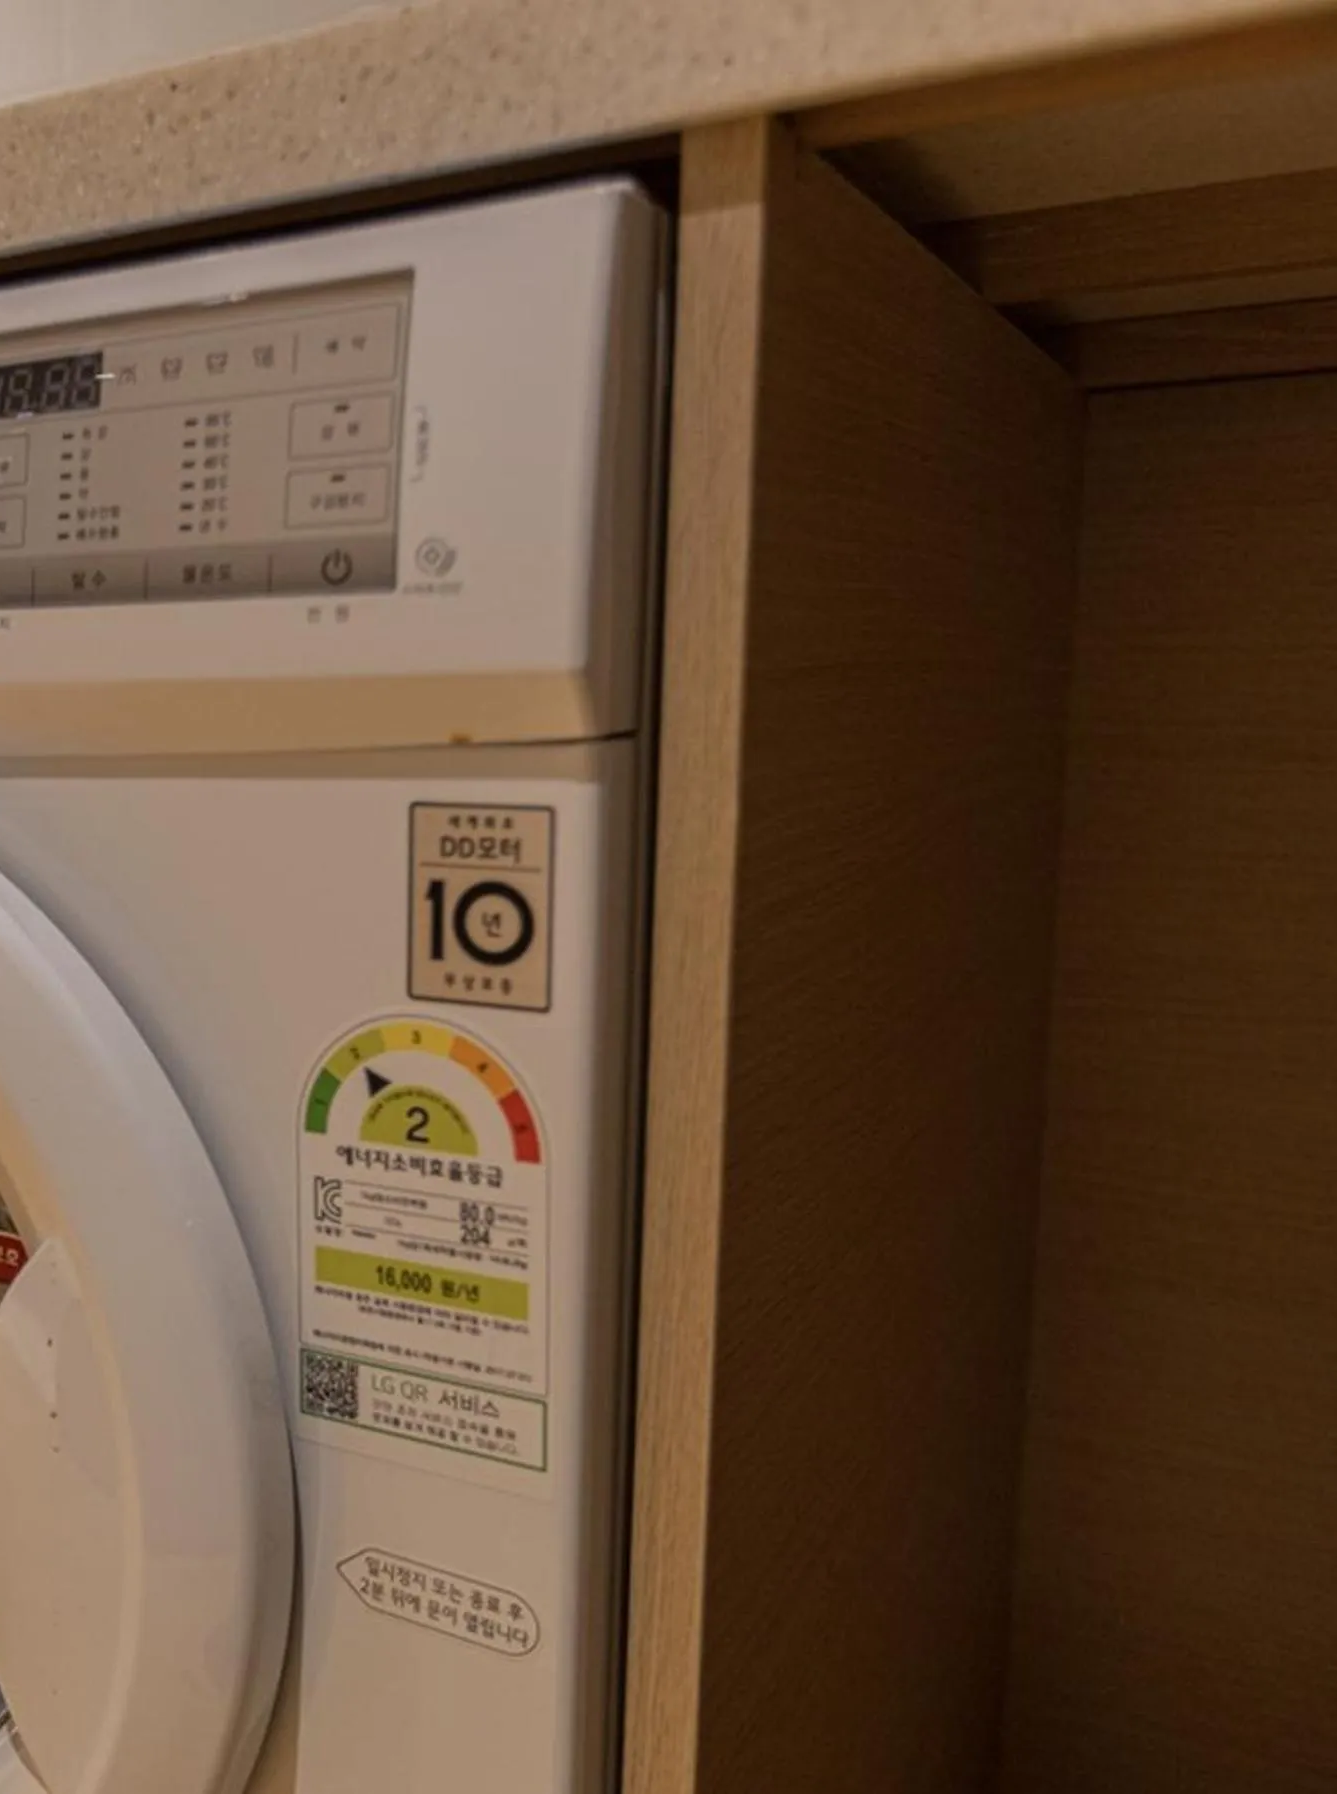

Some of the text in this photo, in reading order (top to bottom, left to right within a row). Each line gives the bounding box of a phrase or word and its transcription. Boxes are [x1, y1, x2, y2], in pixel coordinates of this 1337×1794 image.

[439, 834, 522, 865] DD모터
[425, 877, 536, 968] 10
[480, 911, 503, 938] 년
[405, 1105, 431, 1145] 2
[335, 1145, 504, 1190] 에너지소비효율등급
[376, 1264, 433, 1295] 16,000
[371, 1373, 396, 1396] LG
[400, 1380, 430, 1402] QR
[438, 1388, 501, 1420] 서비스
[360, 1576, 385, 1602] 2분
[391, 1586, 421, 1614] 뒤에
[427, 1600, 458, 1628] 문이
[364, 1555, 427, 1593] 일시정지
[431, 1576, 465, 1606] 또는
[508, 1601, 524, 1622] 후
